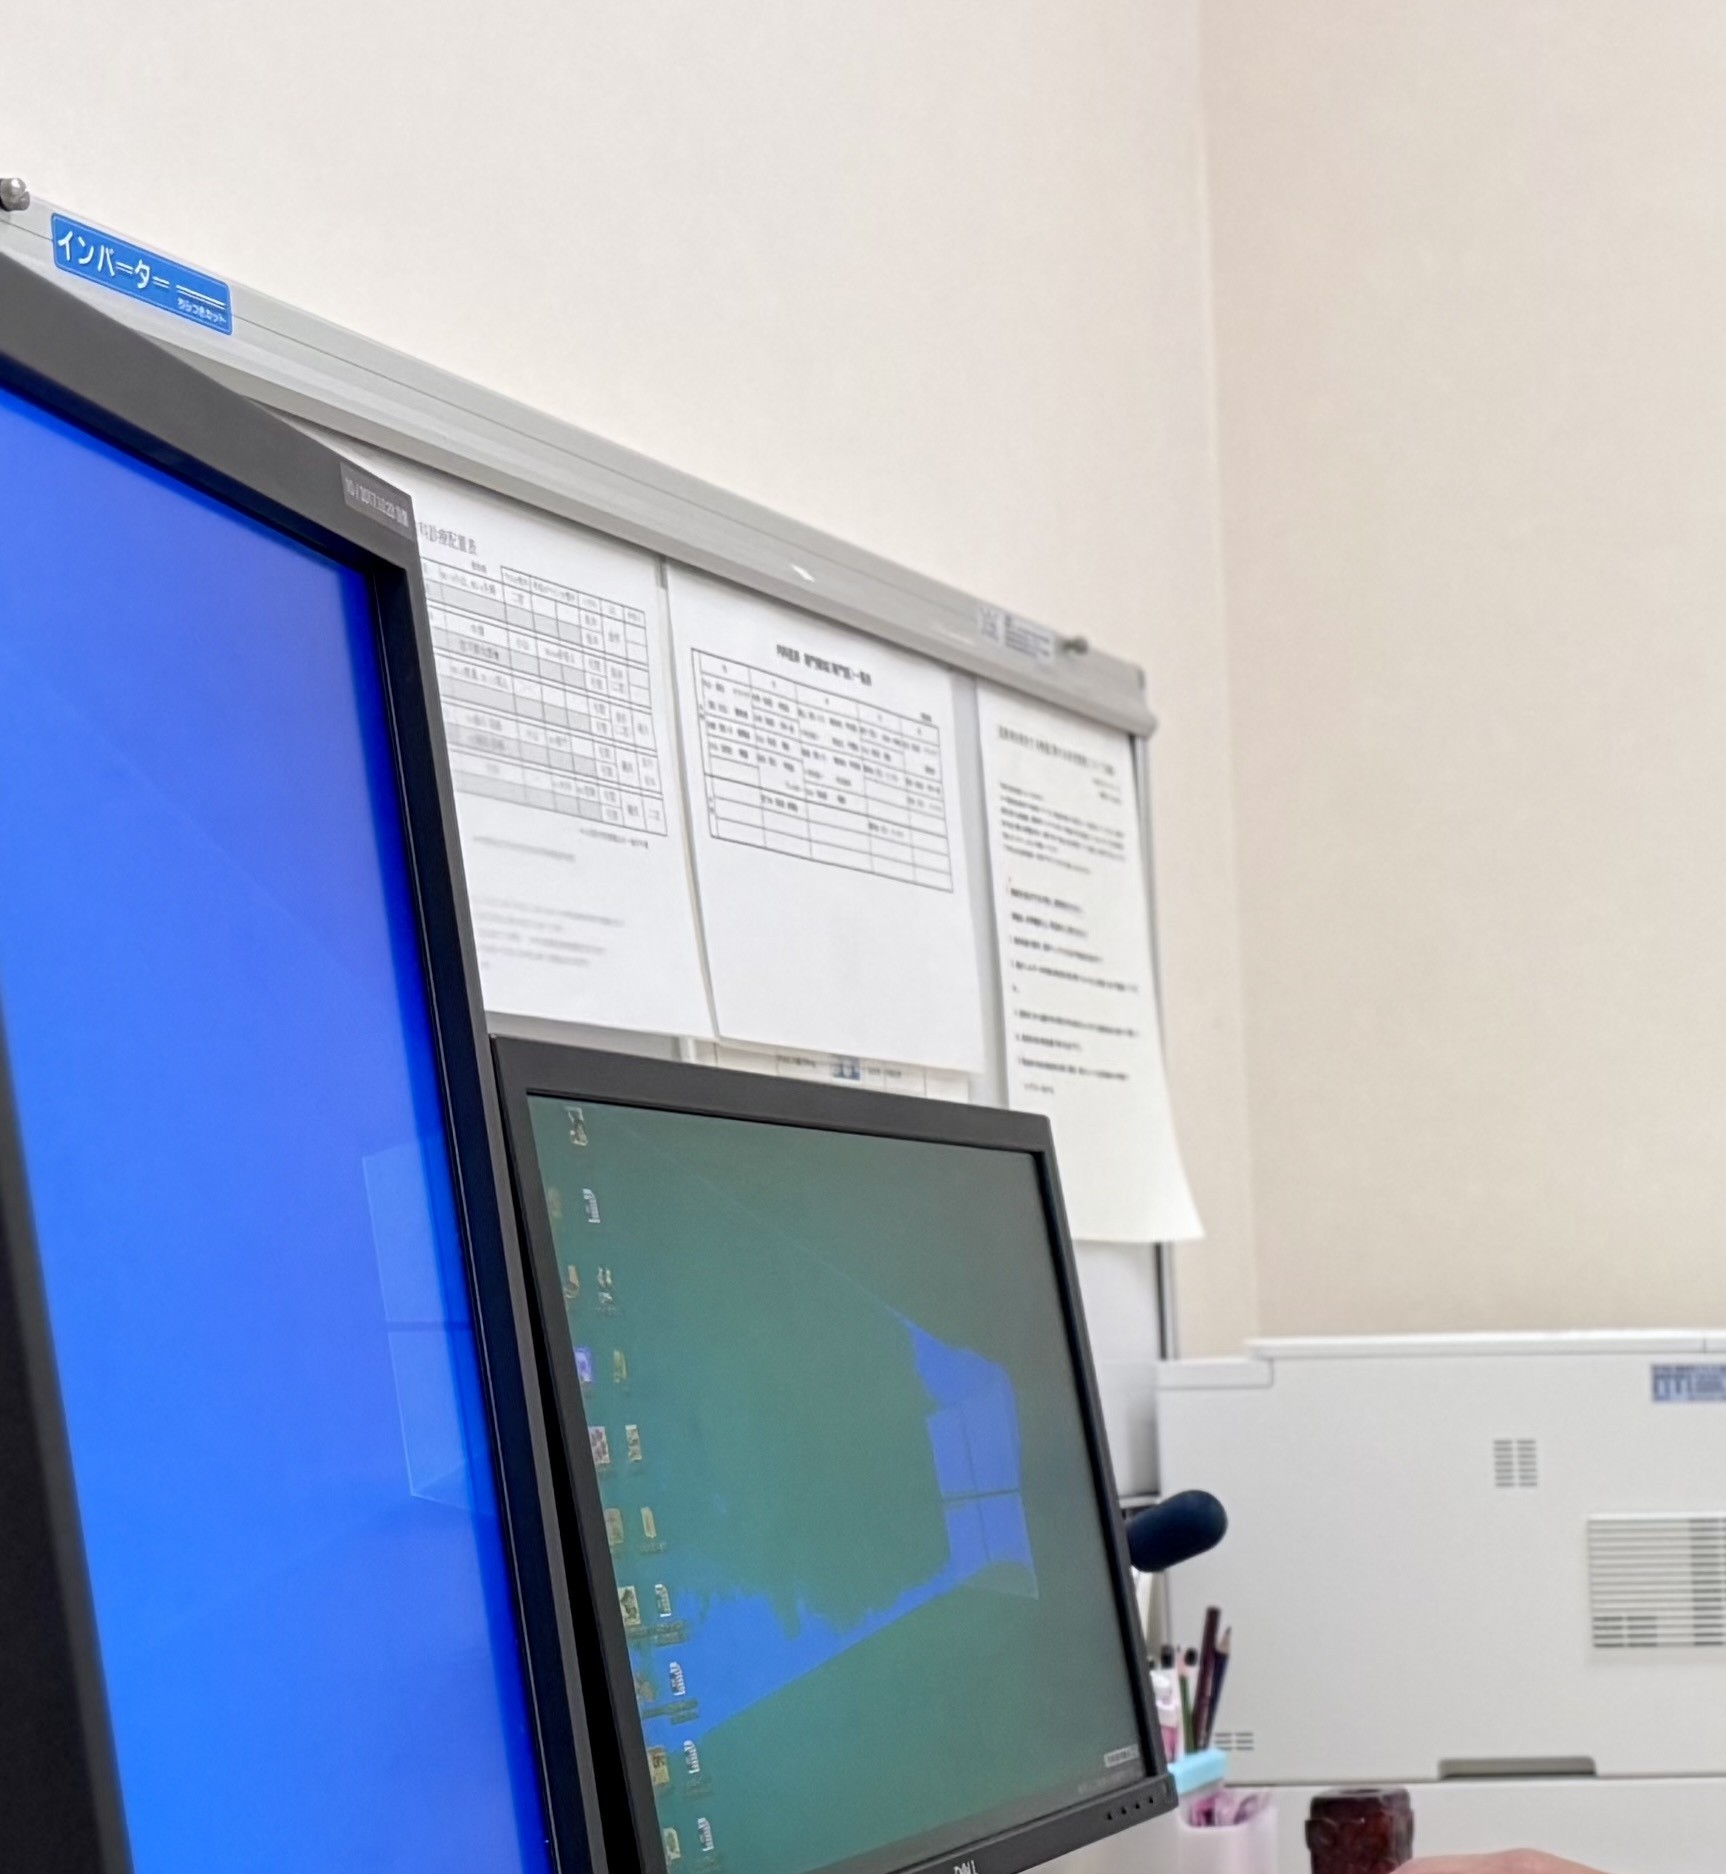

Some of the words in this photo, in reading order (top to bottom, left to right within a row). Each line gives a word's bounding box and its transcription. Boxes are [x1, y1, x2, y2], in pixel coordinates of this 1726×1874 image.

[57, 230, 170, 289] インバーター
